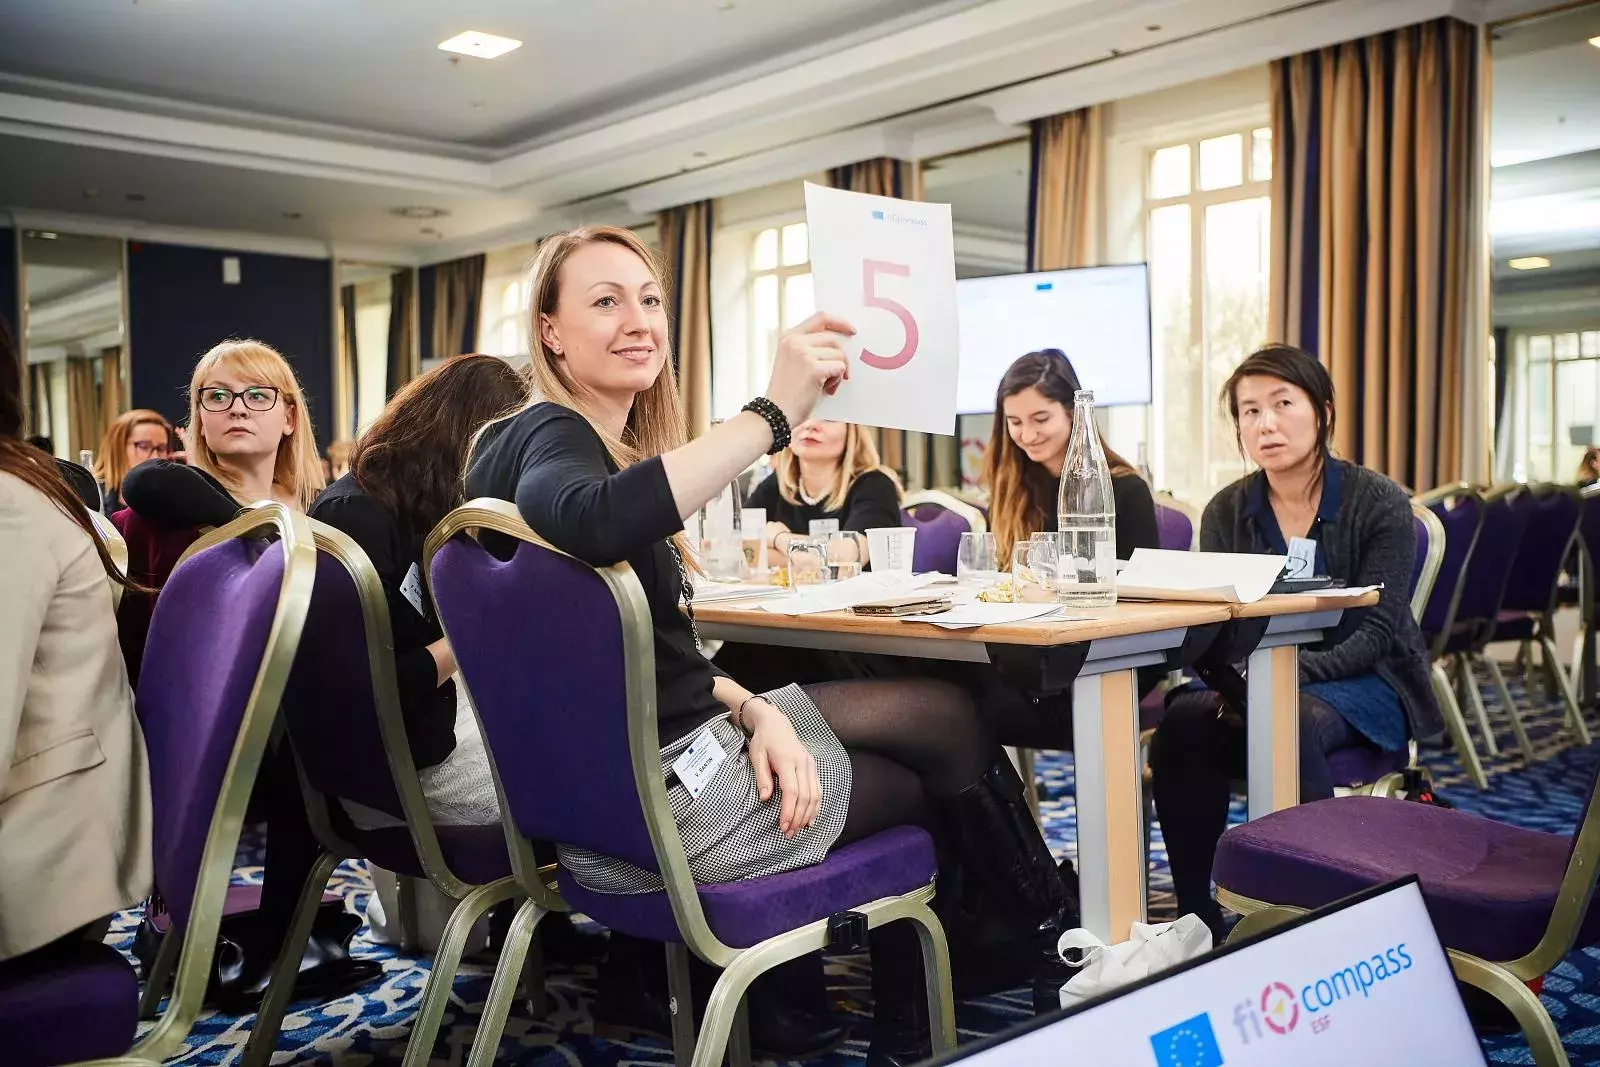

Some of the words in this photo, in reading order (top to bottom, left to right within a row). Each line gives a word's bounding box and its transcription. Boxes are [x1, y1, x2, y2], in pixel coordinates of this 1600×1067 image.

[859, 258, 919, 370] 5
[1301, 943, 1412, 1012] compass
[1310, 1014, 1332, 1035] ESF
